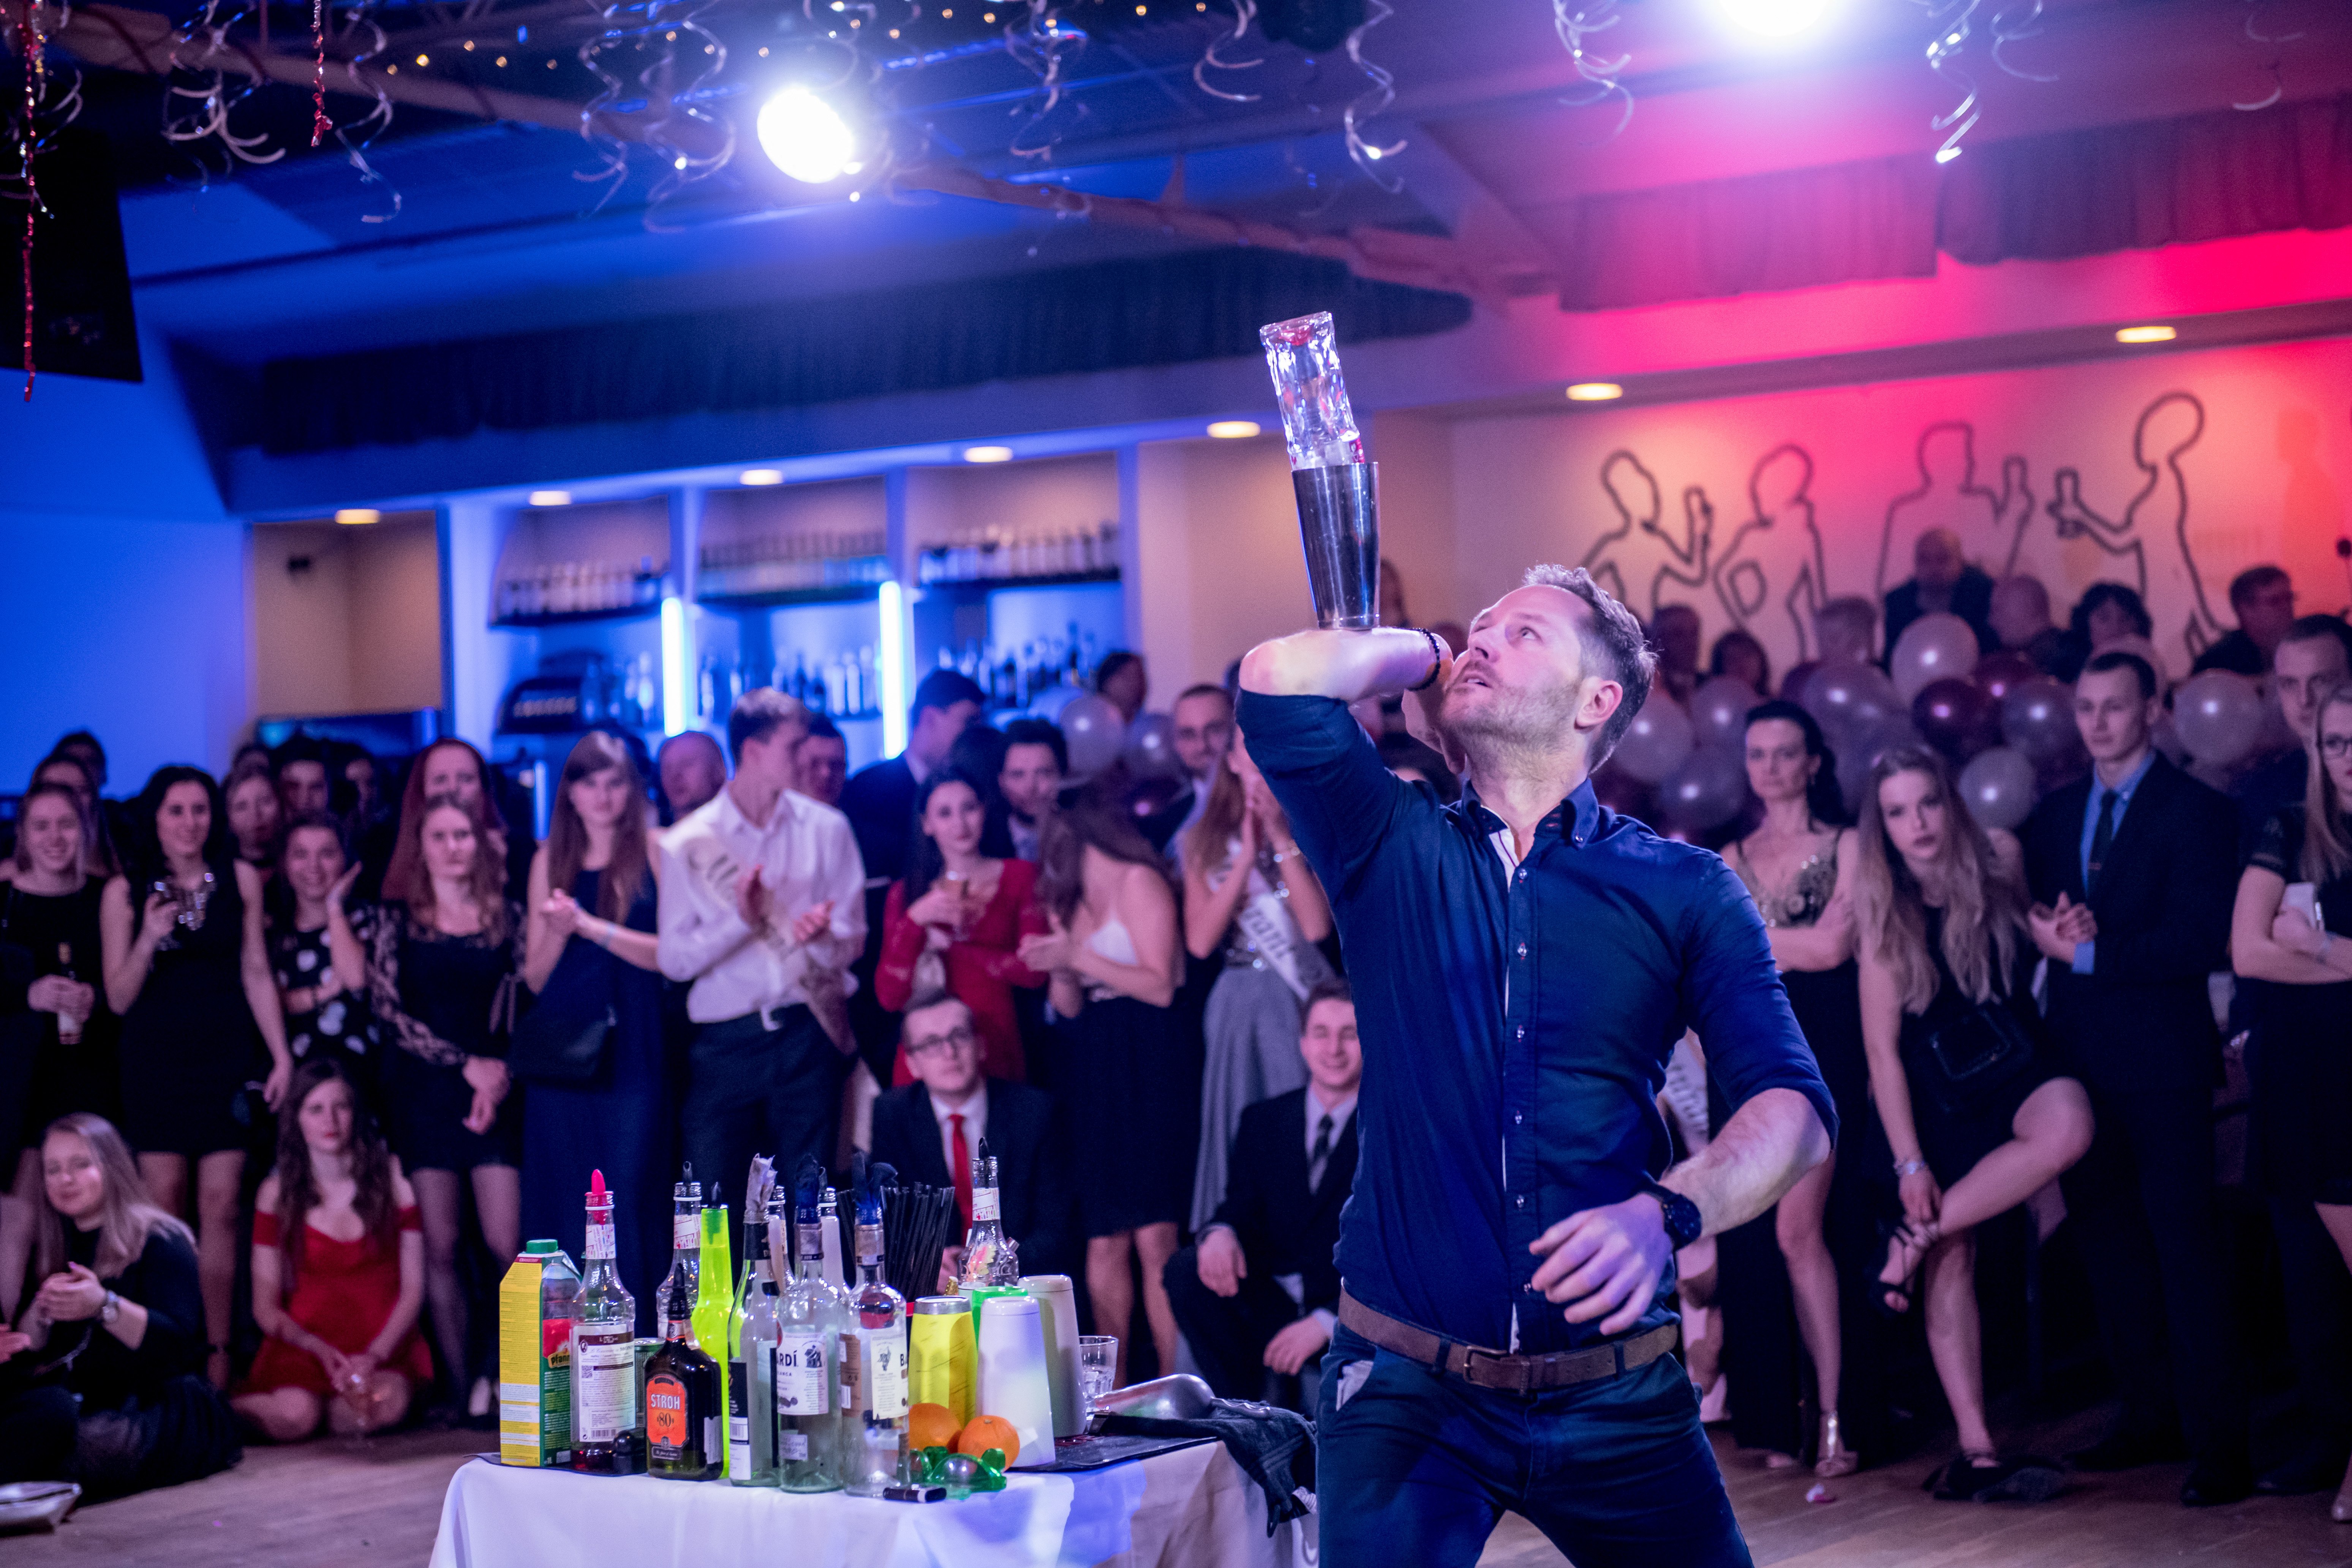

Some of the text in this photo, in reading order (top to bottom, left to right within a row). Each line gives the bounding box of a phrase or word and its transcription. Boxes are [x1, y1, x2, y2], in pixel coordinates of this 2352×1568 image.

[777, 1350, 797, 1367] RDÍ
[651, 1394, 680, 1410] STROH
[659, 1412, 672, 1427] 80
